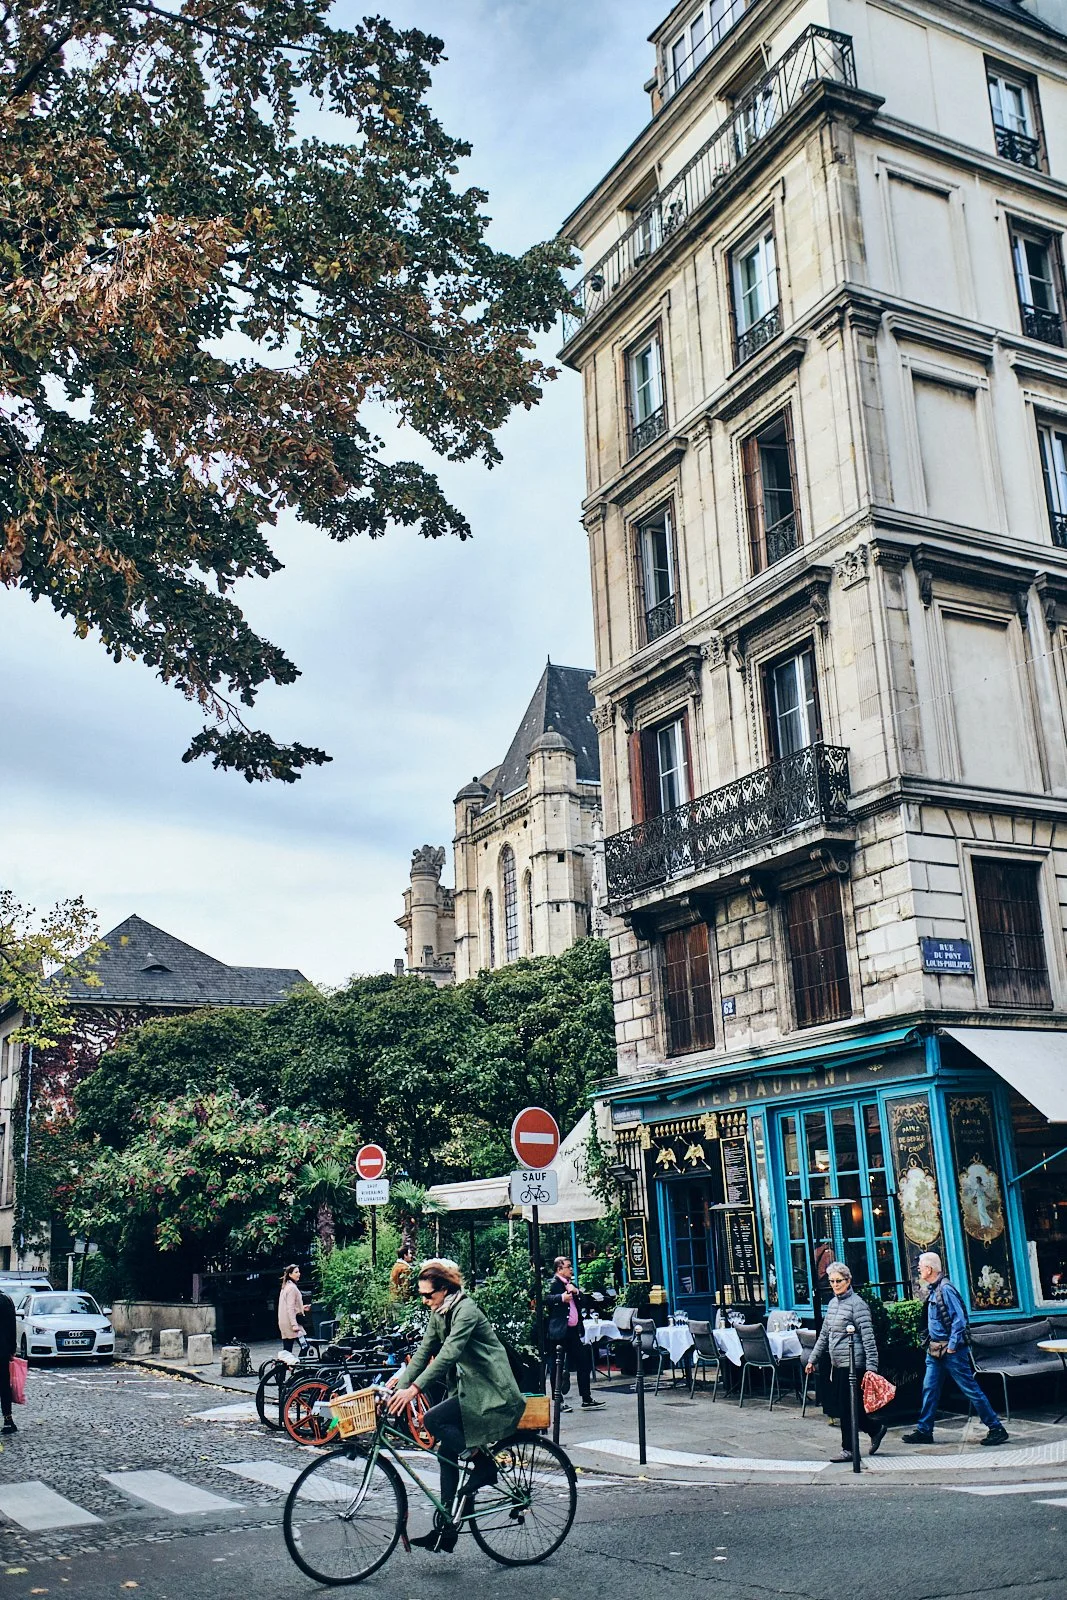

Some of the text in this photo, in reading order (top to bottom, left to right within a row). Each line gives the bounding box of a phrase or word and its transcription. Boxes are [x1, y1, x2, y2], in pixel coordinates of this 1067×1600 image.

[939, 943, 954, 951] RUE
[933, 951, 961, 960] DU PONT
[723, 1001, 734, 1015] 62
[522, 1172, 547, 1181] SAUF
